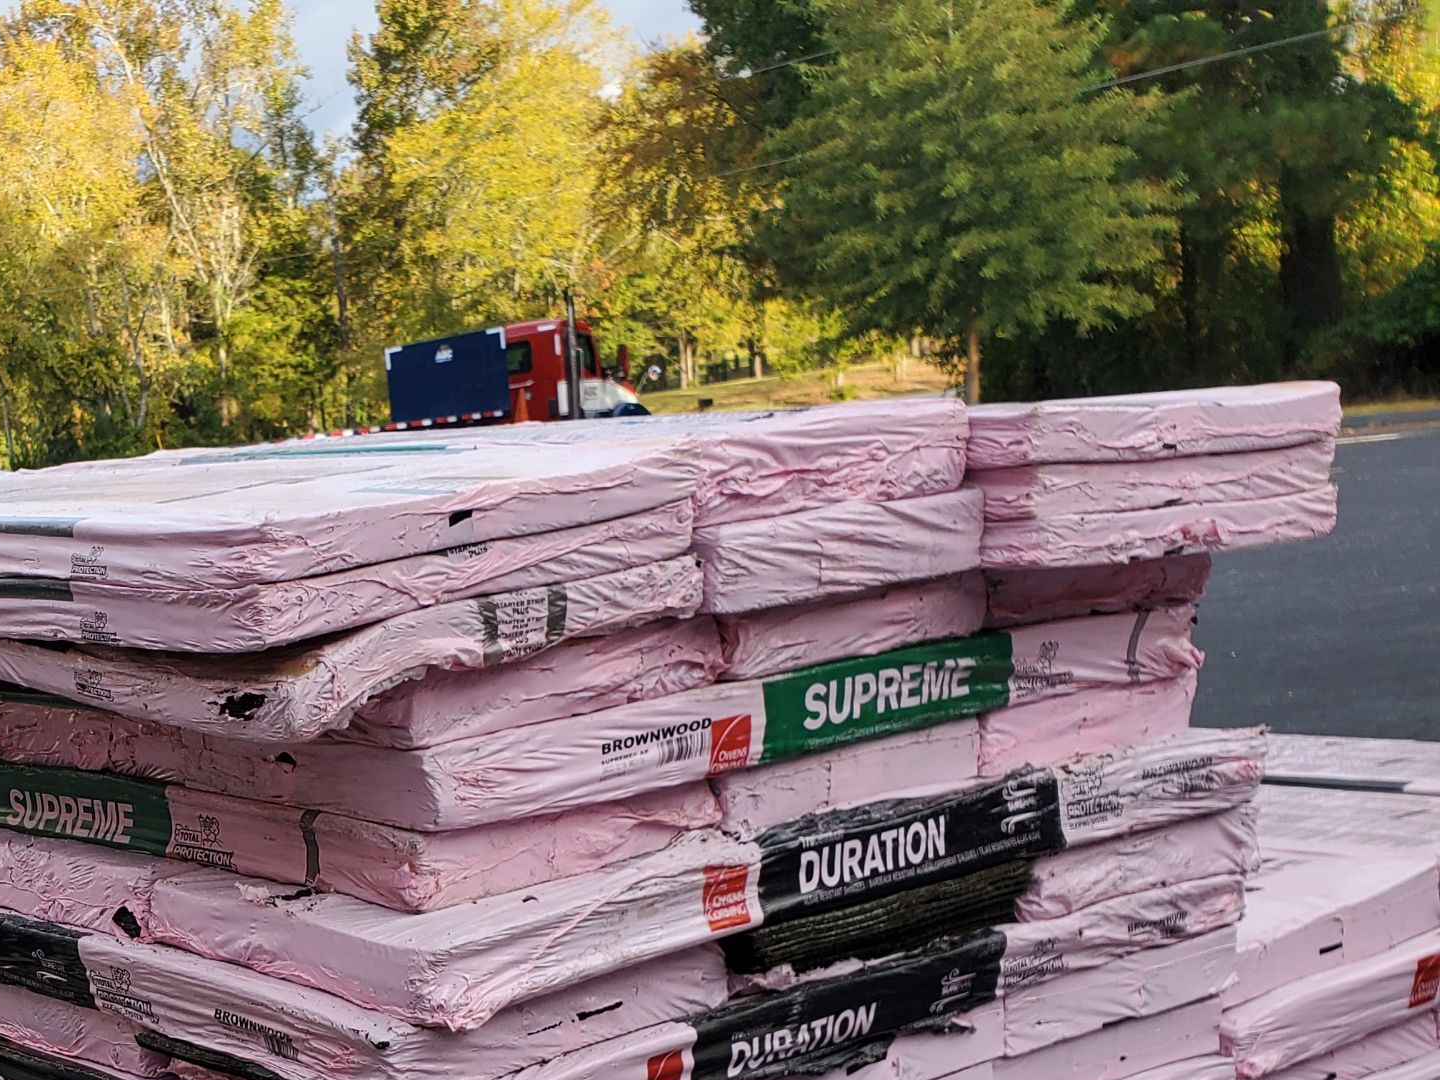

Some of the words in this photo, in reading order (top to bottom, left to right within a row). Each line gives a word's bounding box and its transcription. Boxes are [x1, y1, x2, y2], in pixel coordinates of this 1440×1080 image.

[72, 565, 106, 575] PROTECTION
[77, 683, 111, 698] OTECTION
[802, 656, 977, 731] SUPREME
[601, 717, 712, 755] BROWNWOOD
[6, 788, 135, 843] SUPREME
[173, 845, 233, 867] PROTECTION
[179, 831, 201, 845] TOTAL
[798, 814, 946, 894] DURATION
[726, 1002, 878, 1078] DURATION
